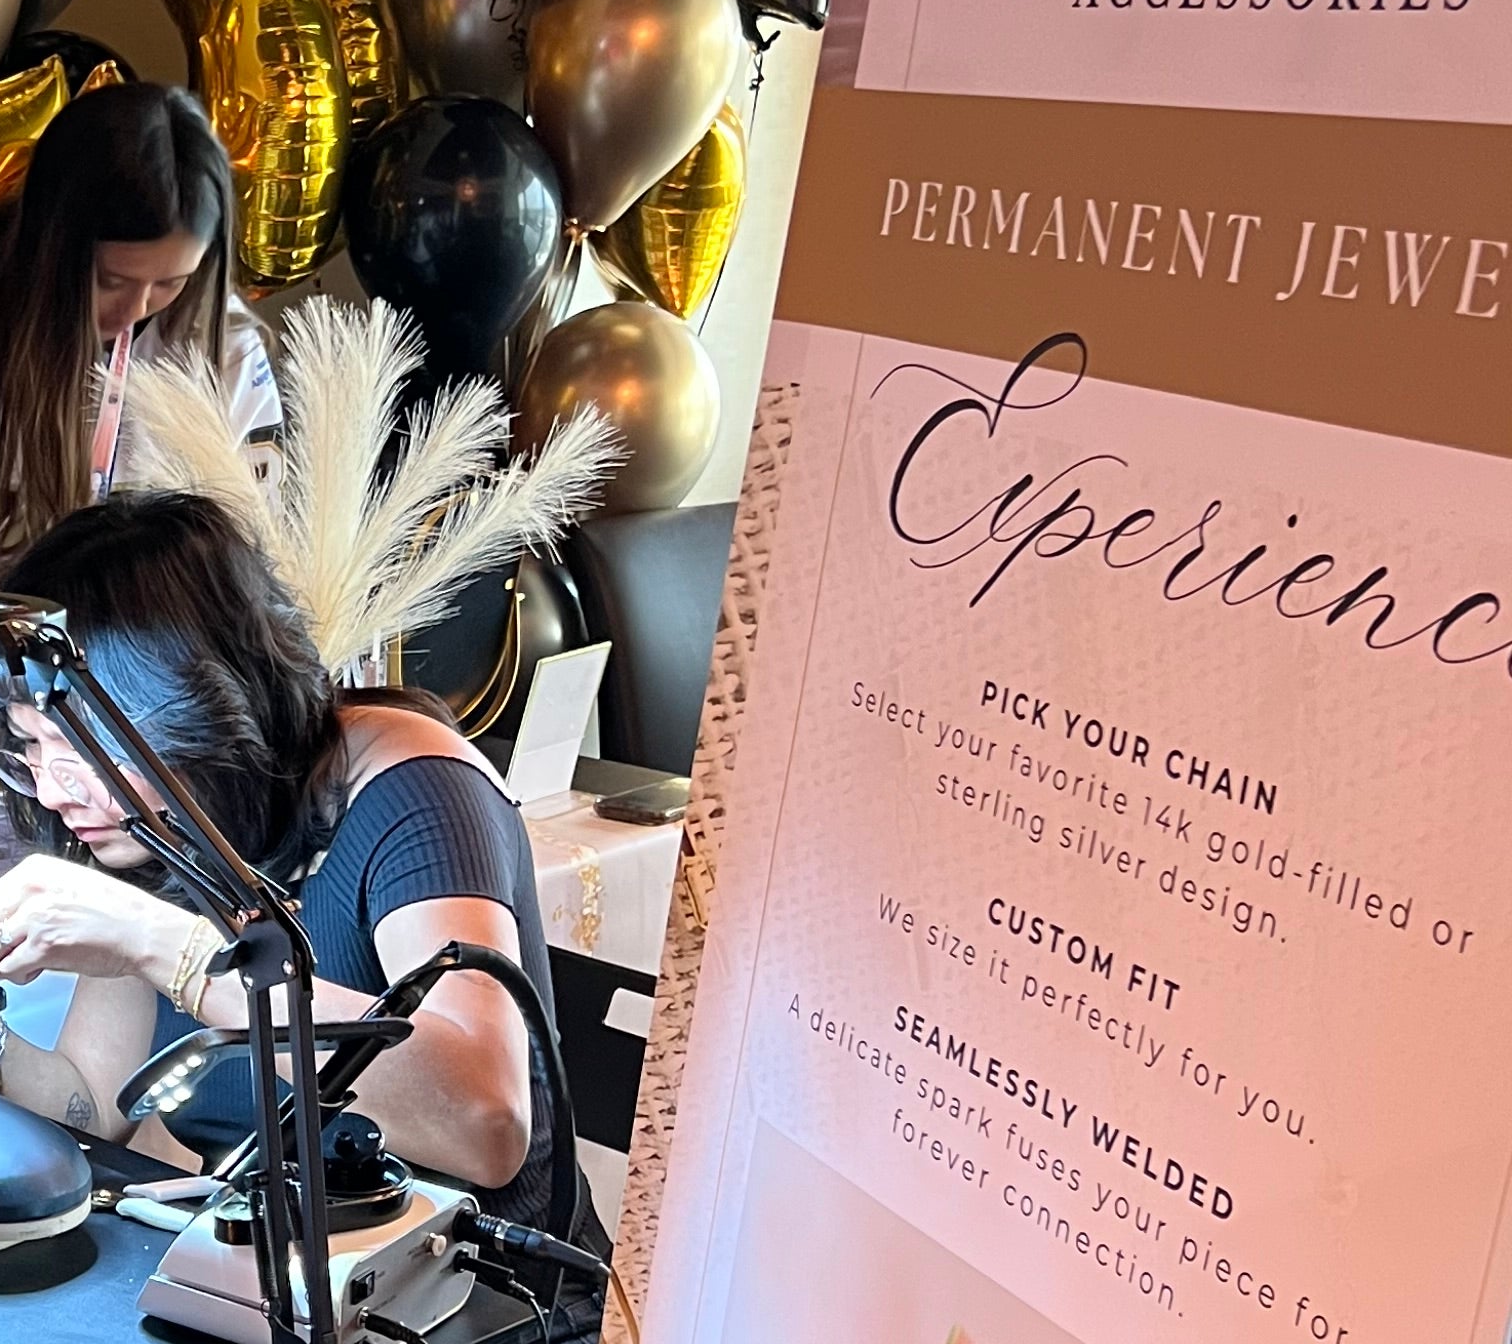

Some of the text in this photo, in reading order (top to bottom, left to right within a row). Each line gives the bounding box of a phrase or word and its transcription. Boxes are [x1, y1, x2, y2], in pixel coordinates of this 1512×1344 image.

[879, 178, 1510, 319] PERMANENT JEWE
[870, 332, 1512, 678] Experienc
[851, 681, 1475, 954] Select your favorite 14k gold-filled or
[980, 679, 1278, 816] PICK YOUR CHAIN
[935, 773, 1287, 944] sterling silver design.
[987, 897, 1181, 1011] CUSTOM FIT
[879, 892, 1315, 1145] We size it perfectly for you.
[893, 1005, 1234, 1220] SEAMLESSLY WELDED
[787, 993, 800, 1020] A
[810, 1008, 907, 1085] delicate
[916, 1077, 993, 1139] spark
[1005, 1122, 1082, 1192] fuses
[1091, 1182, 1167, 1242] your
[1178, 1235, 1276, 1309] piece
[892, 1108, 1184, 1318] forever connection.
